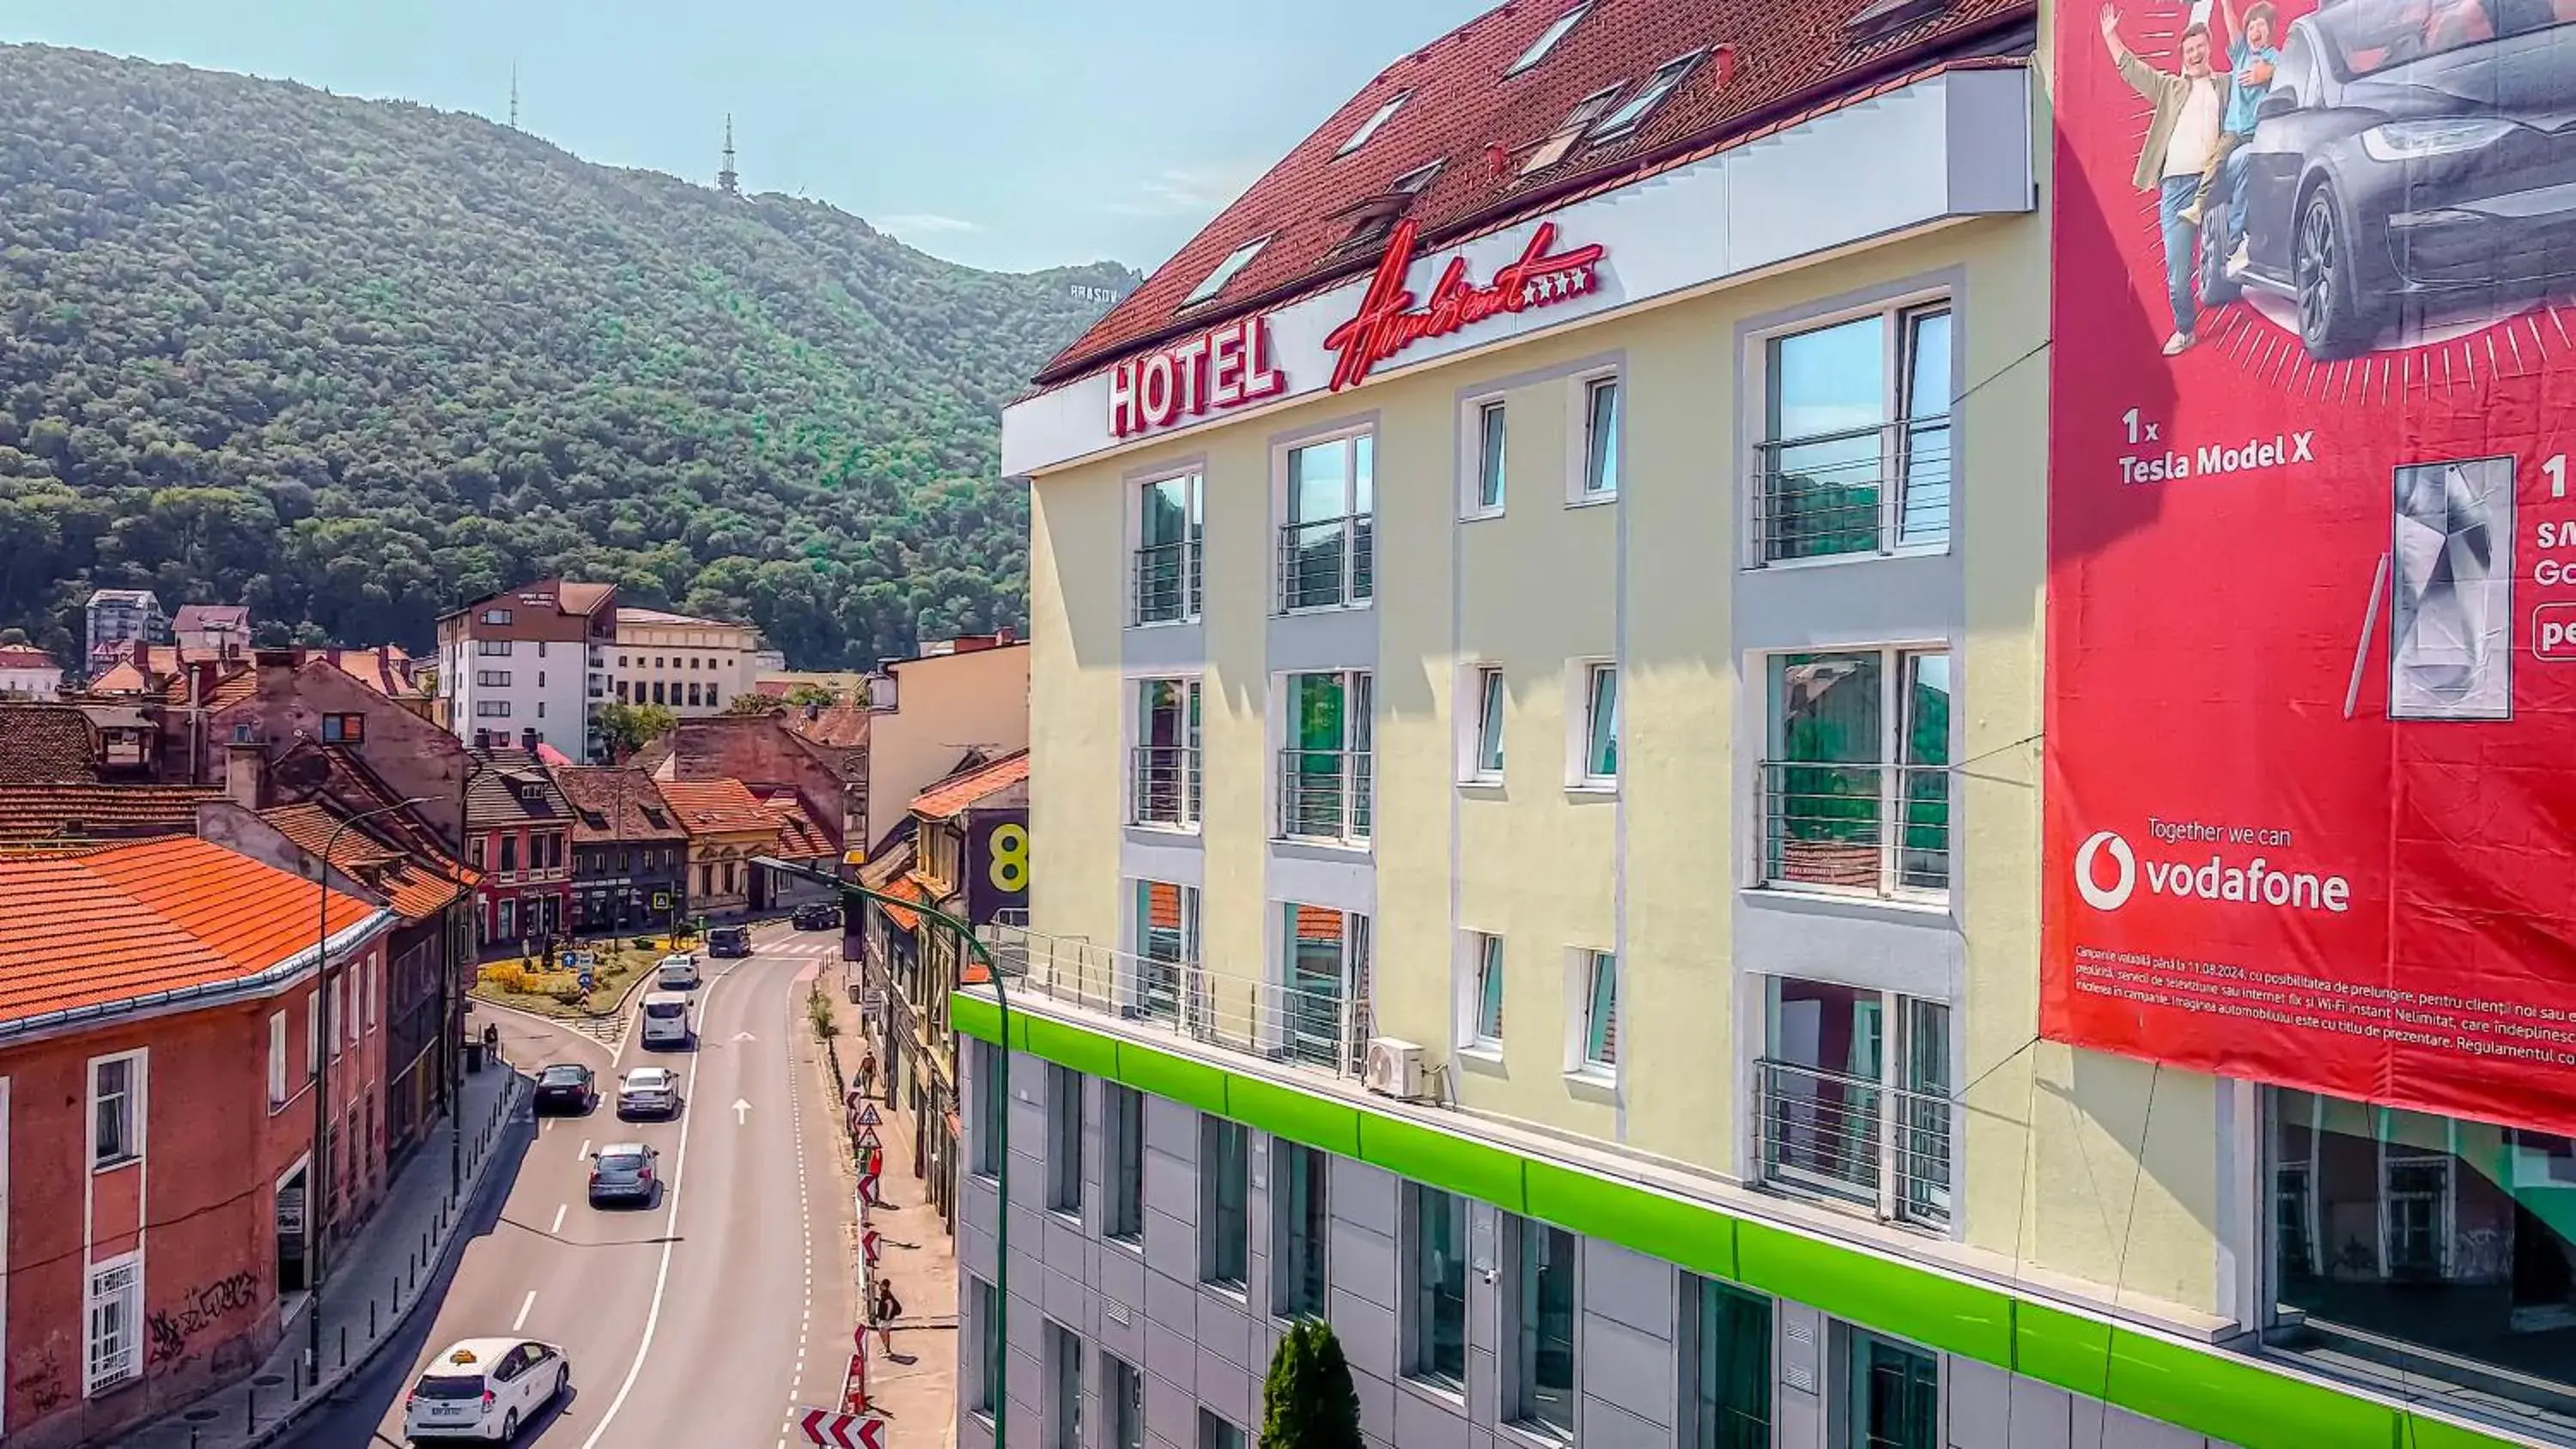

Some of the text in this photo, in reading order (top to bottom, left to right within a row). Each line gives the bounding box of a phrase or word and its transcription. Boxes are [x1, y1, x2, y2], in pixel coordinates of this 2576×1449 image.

[1109, 216, 1603, 436] HOTEL Ambient
[2122, 408, 2160, 444] 1 x
[2118, 430, 2314, 484] Tesla Model X
[2148, 817, 2292, 847] Together we can
[2145, 856, 2351, 912] vodafone
[2151, 974, 2163, 986] de
[2221, 985, 2241, 997] sau
[2242, 986, 2285, 1004] internet
[2288, 992, 2301, 1006] fix
[2461, 1019, 2489, 1033] care
[2177, 959, 2185, 971] la
[2249, 971, 2263, 982] cu
[2264, 972, 2331, 991] posibilitatea
[2333, 980, 2348, 993] de
[2419, 993, 2462, 1009] pentru
[2515, 1004, 2537, 1017] noi
[2540, 1008, 2565, 1021] sau
[2172, 996, 2216, 1011] Imaginea
[2218, 1003, 2294, 1024] automobilului
[2295, 1014, 2319, 1028] este
[2321, 1019, 2336, 1031] cu
[2338, 1019, 2362, 1034] titlu
[2364, 1024, 2381, 1037] de
[2383, 1029, 2453, 1048] prezentare.
[2457, 1036, 2555, 1062] Regulamentul
